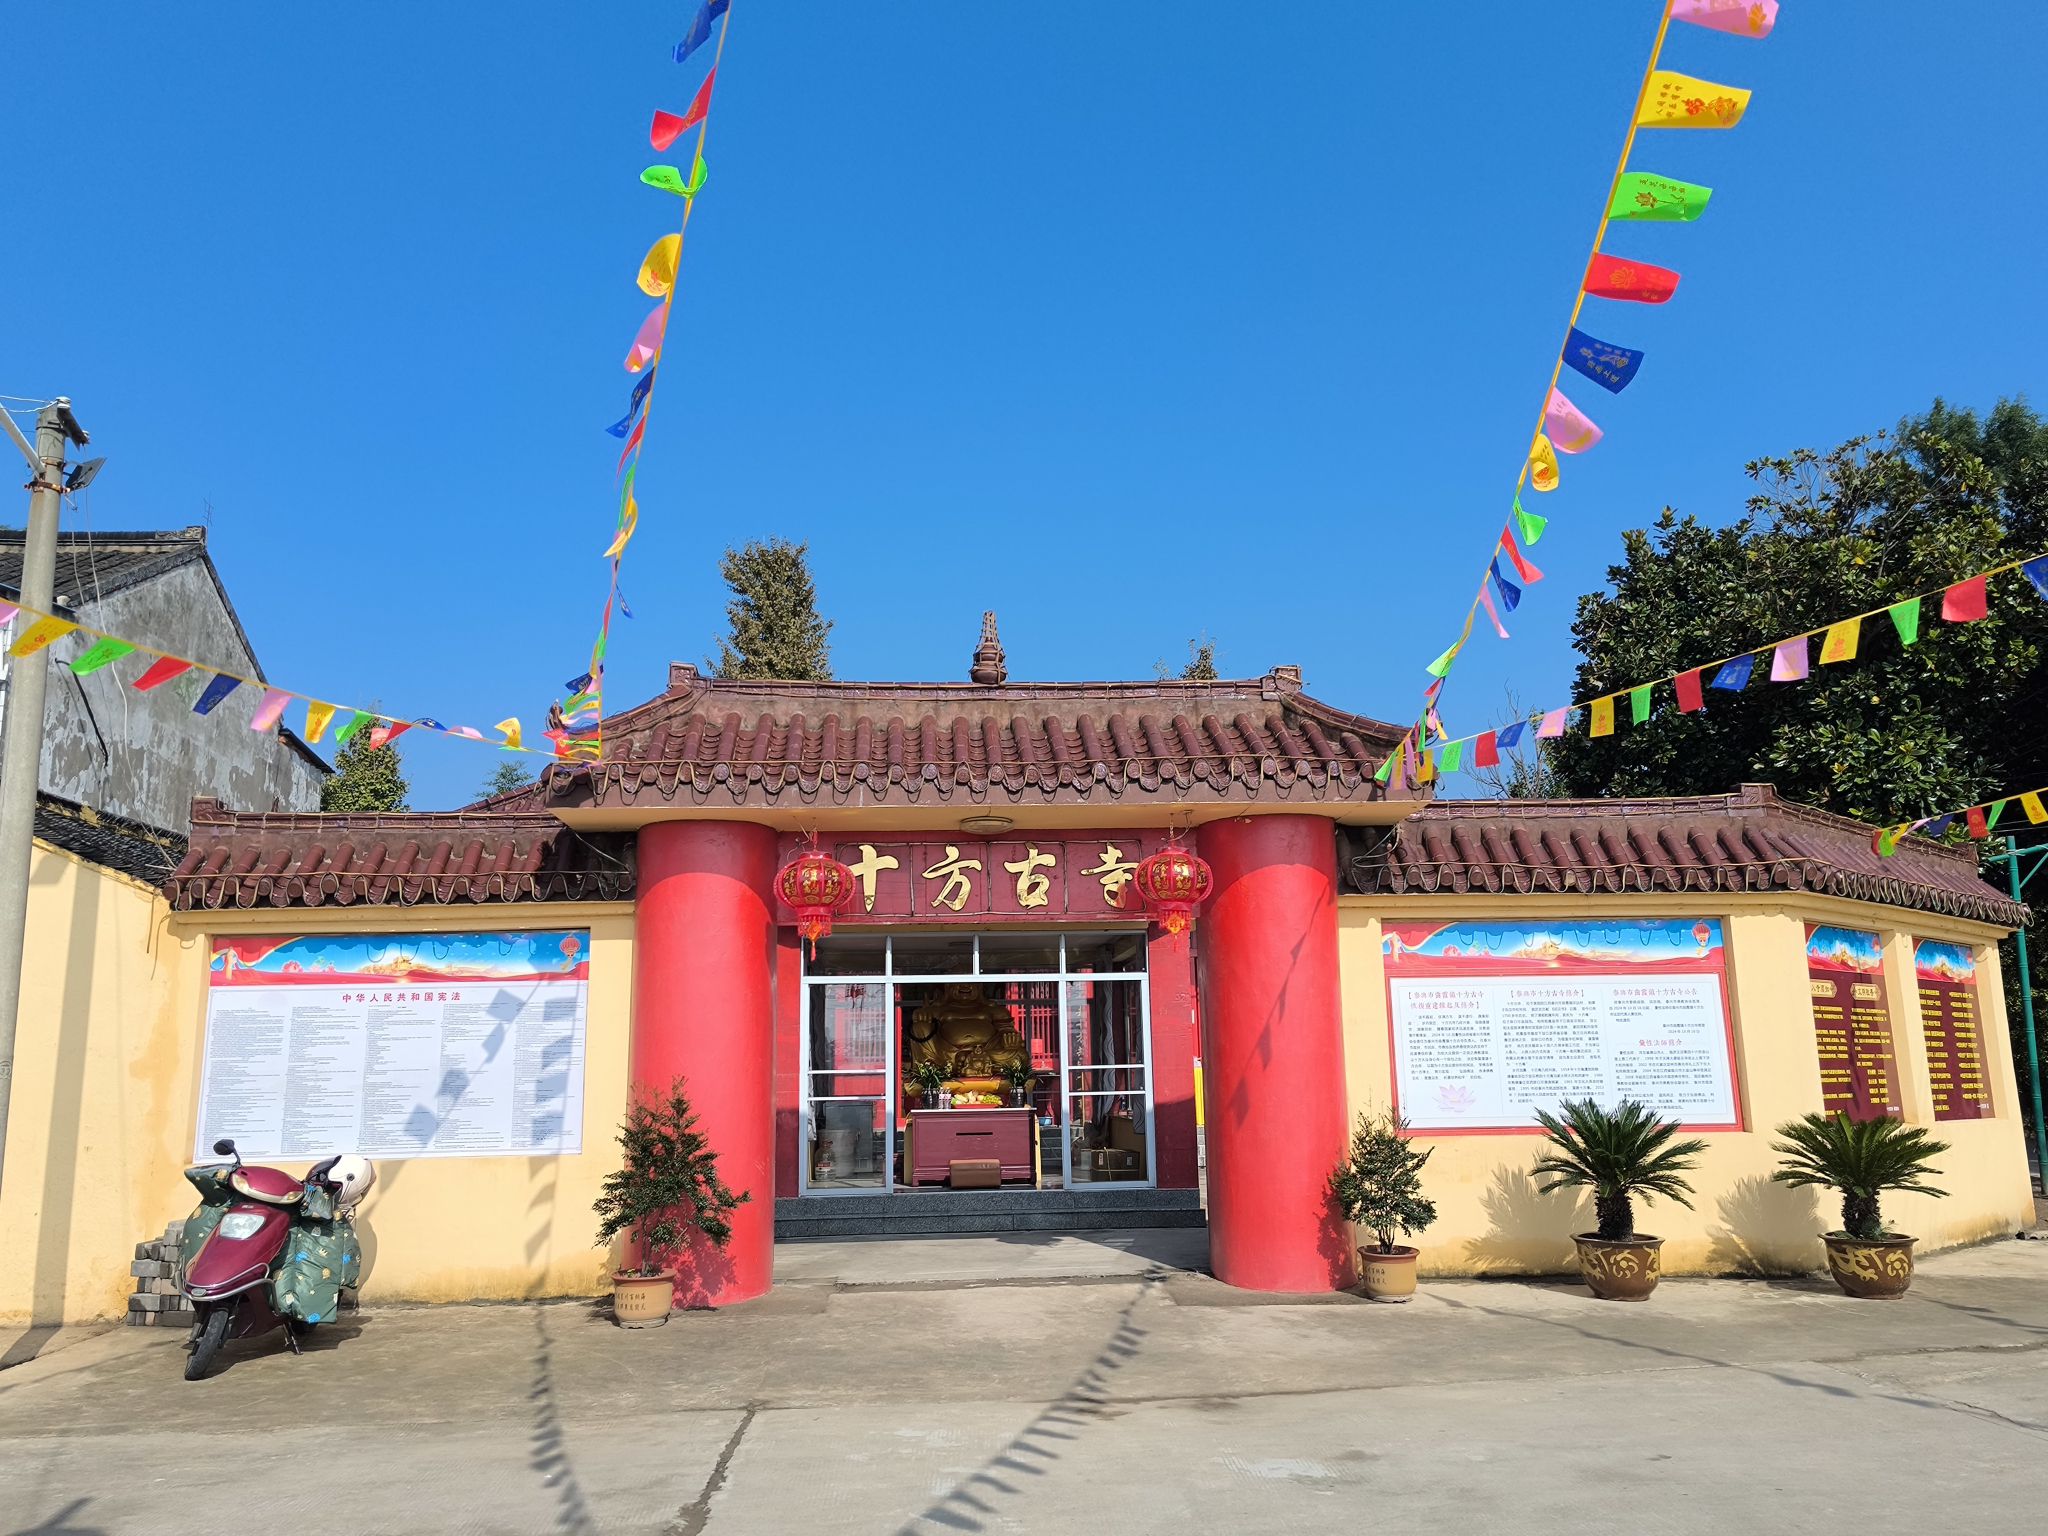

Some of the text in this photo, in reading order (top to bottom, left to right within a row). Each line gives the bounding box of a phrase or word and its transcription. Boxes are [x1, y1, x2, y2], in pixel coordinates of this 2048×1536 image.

[851, 843, 1138, 912] 十方古寺
[342, 992, 462, 1004] 中华人民共和国宪法
